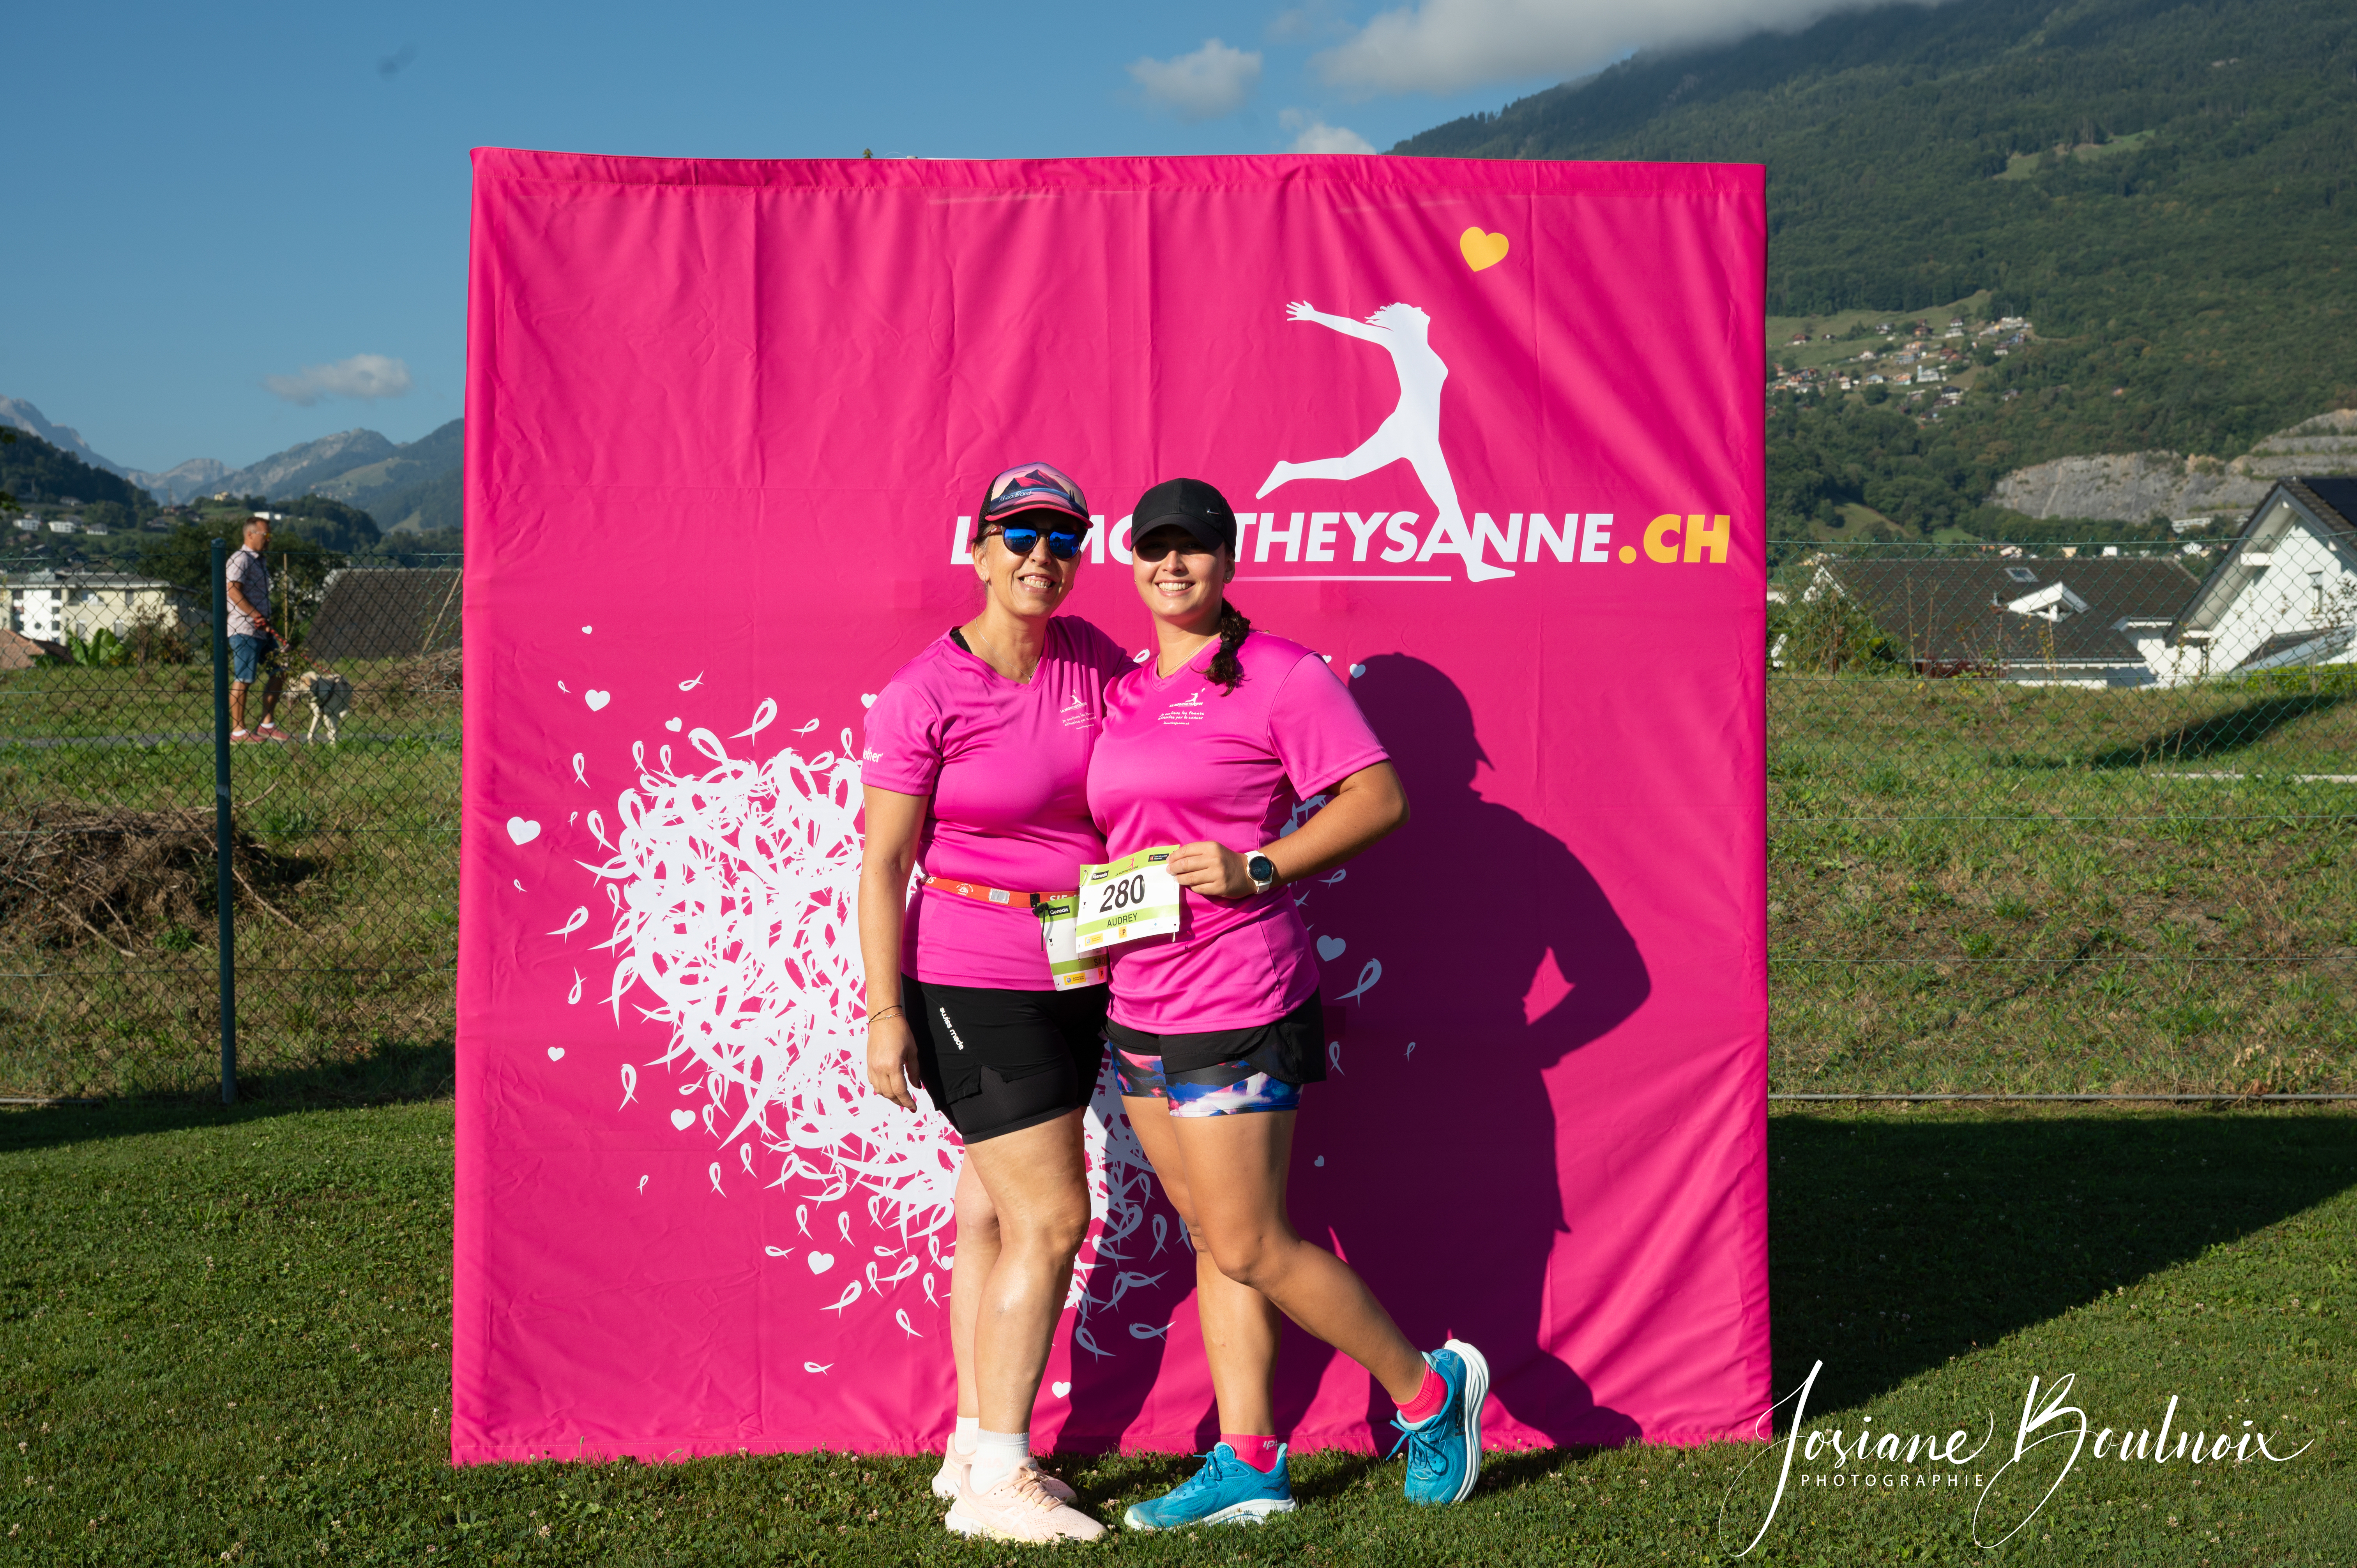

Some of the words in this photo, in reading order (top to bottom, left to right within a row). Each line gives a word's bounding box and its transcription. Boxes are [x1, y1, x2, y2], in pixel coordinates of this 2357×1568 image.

[951, 516, 974, 564] L
[1080, 512, 1730, 565] THEYSANNE.CH
[1099, 874, 1145, 913] 280
[1107, 913, 1138, 927] AUDREY
[940, 1007, 952, 1029] swiss
[949, 1029, 964, 1050] made
[959, 1429, 978, 1440] FIL
[977, 1457, 1004, 1468] FILA
